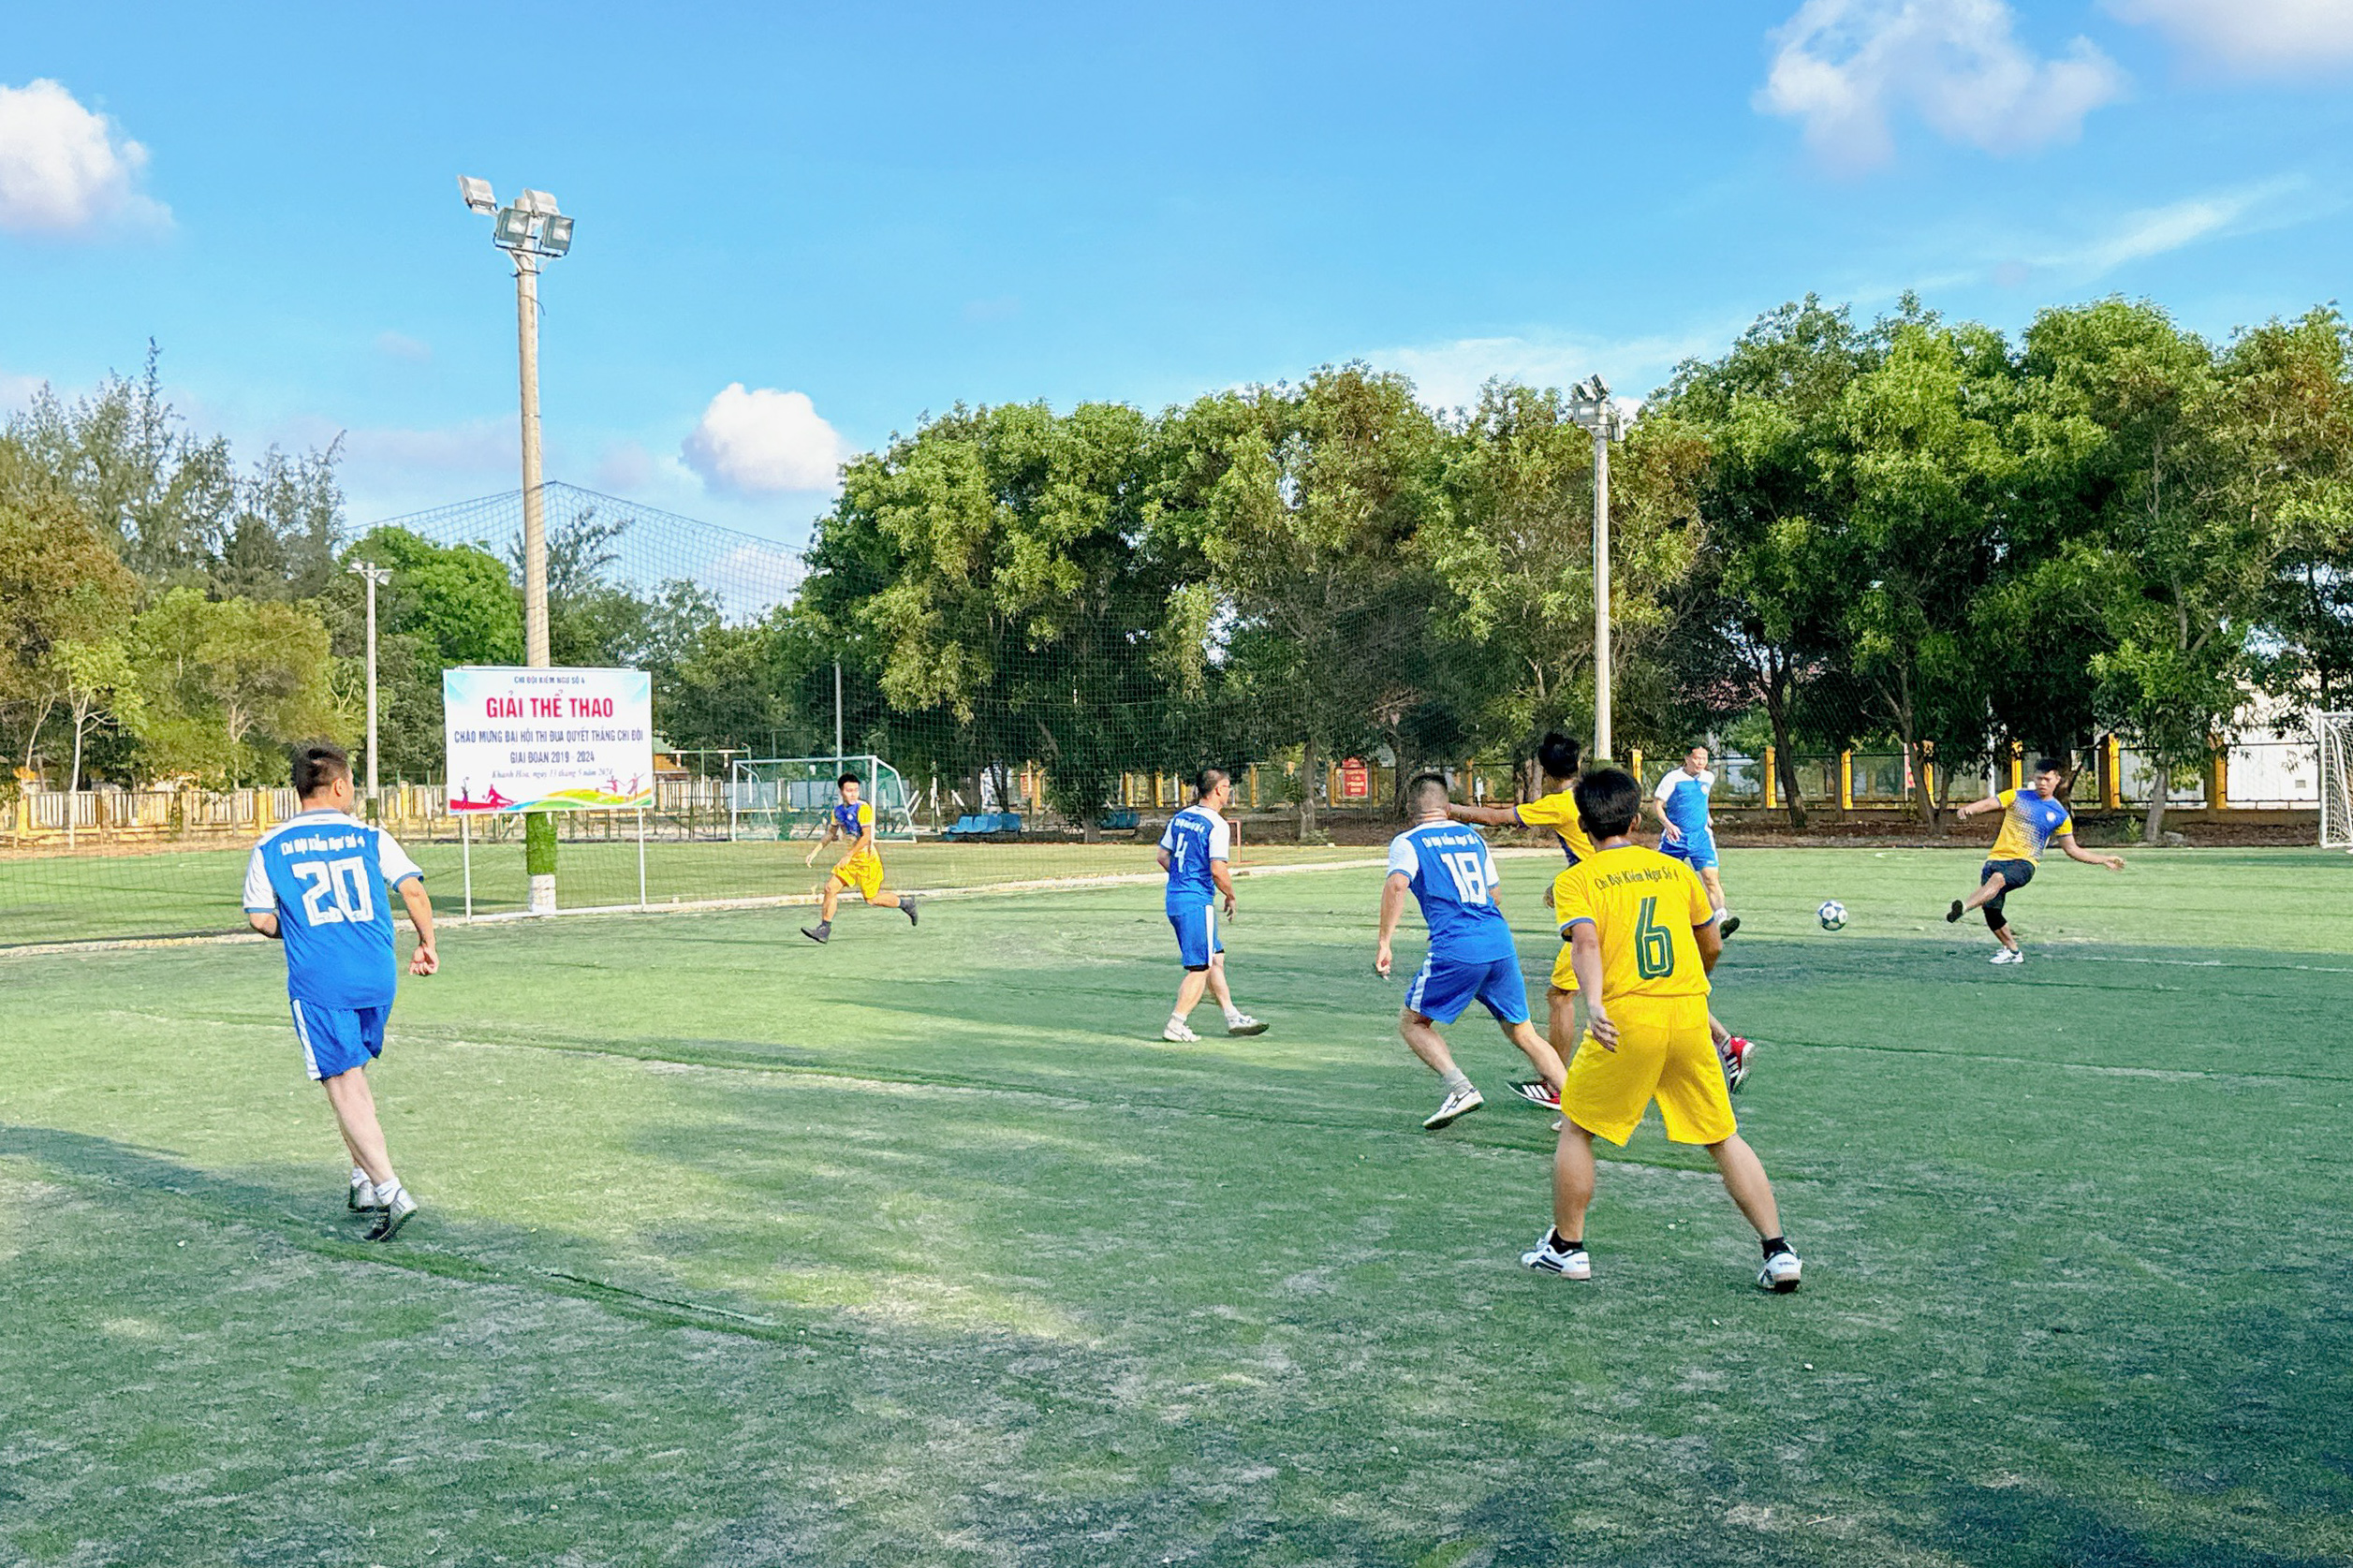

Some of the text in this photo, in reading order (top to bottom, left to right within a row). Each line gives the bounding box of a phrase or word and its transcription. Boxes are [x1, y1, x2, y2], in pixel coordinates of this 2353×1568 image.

[486, 689, 614, 718] GIẢI THỂ THAO
[536, 730, 548, 742] THI
[549, 730, 564, 742] ĐUA
[617, 729, 629, 741] CHI
[510, 751, 525, 764] GIAI
[551, 751, 569, 764] 2019
[577, 750, 595, 763] 2024
[1174, 832, 1188, 873] 4
[291, 857, 374, 927] 20
[1440, 852, 1487, 905] 18
[1635, 896, 1674, 980] 6
